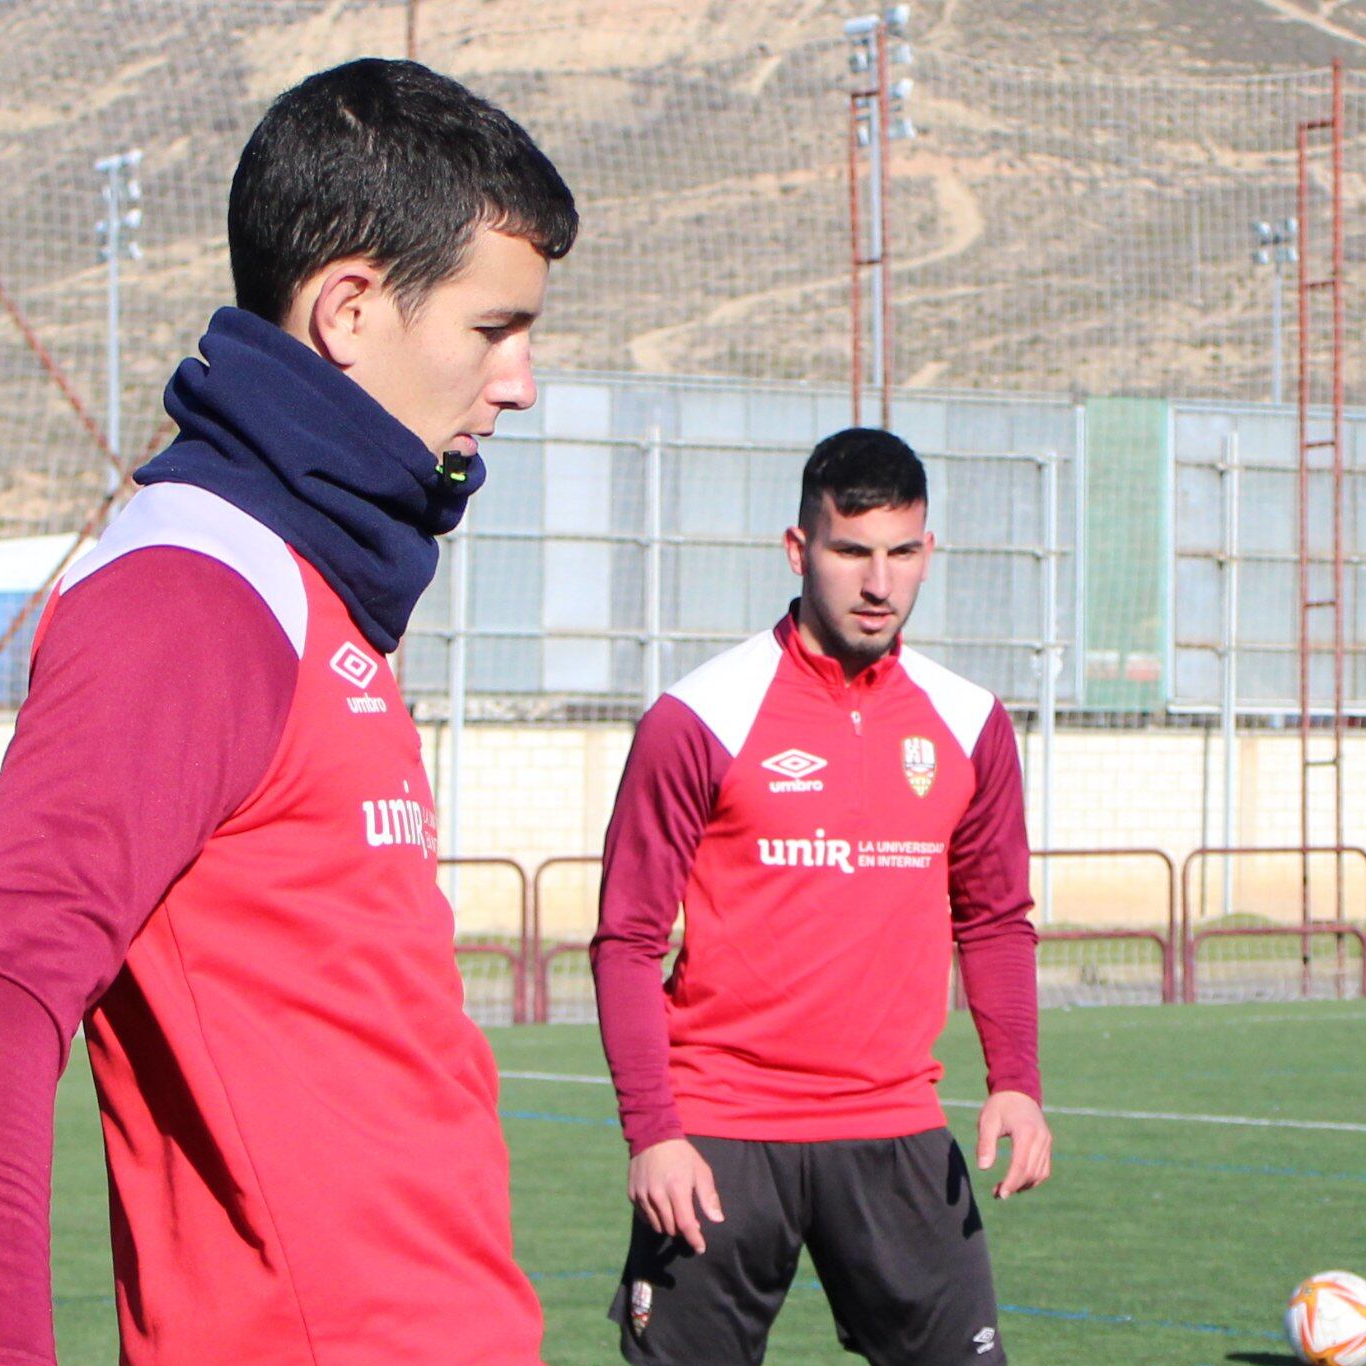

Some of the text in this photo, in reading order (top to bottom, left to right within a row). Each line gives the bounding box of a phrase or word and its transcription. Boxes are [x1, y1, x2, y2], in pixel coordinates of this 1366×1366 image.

[347, 693, 387, 713] umbro
[769, 779, 824, 793] umbro
[858, 840, 874, 853] LA
[858, 855, 932, 868] EN INTERNET
